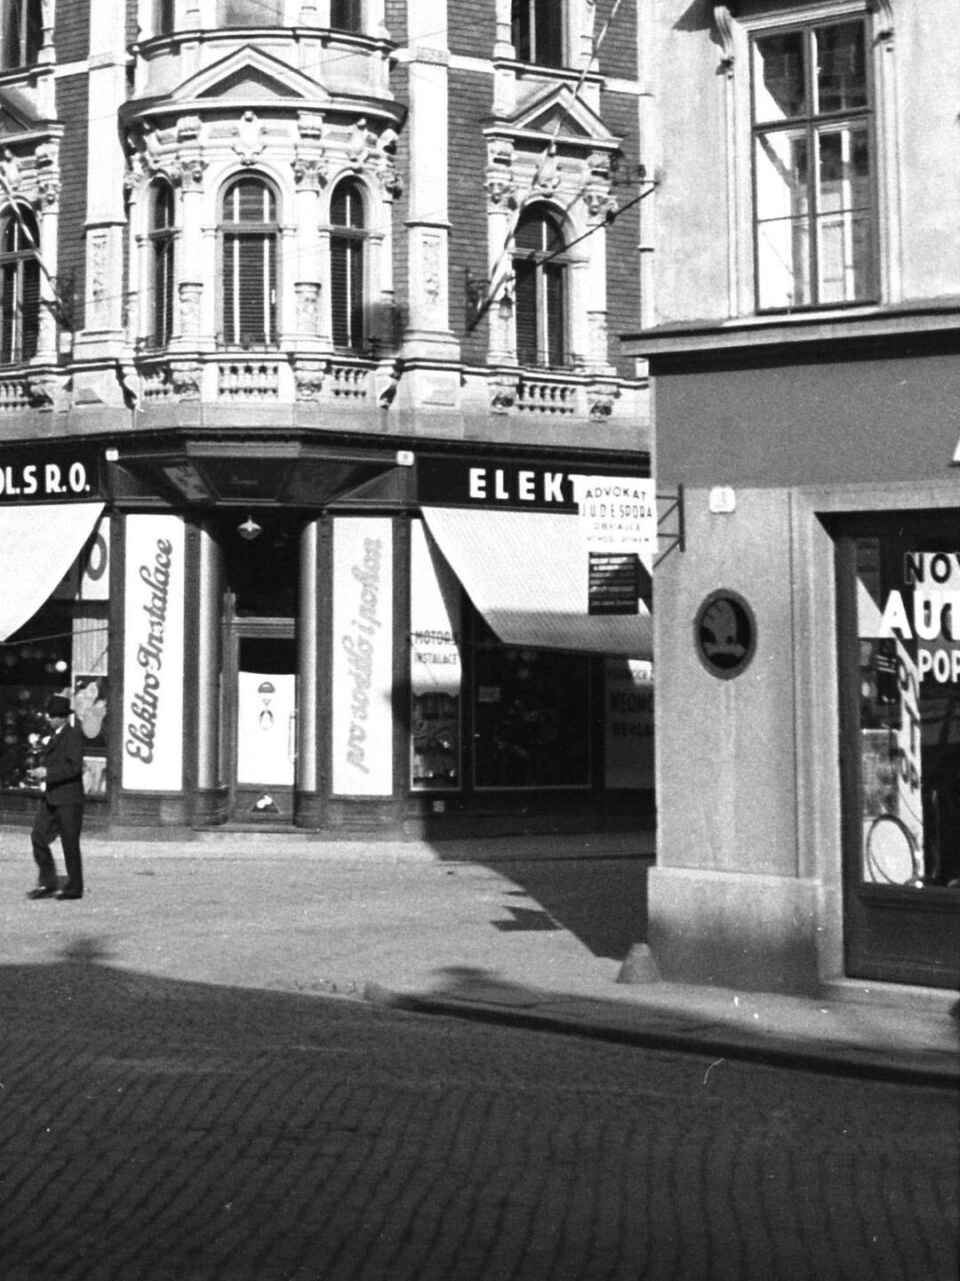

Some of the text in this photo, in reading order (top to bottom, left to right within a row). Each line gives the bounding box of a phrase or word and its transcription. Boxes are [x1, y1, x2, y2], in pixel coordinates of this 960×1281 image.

[585, 486, 646, 501] ADVOKAT
[904, 551, 960, 585] NO
[125, 538, 173, 764] Elektro Instalace
